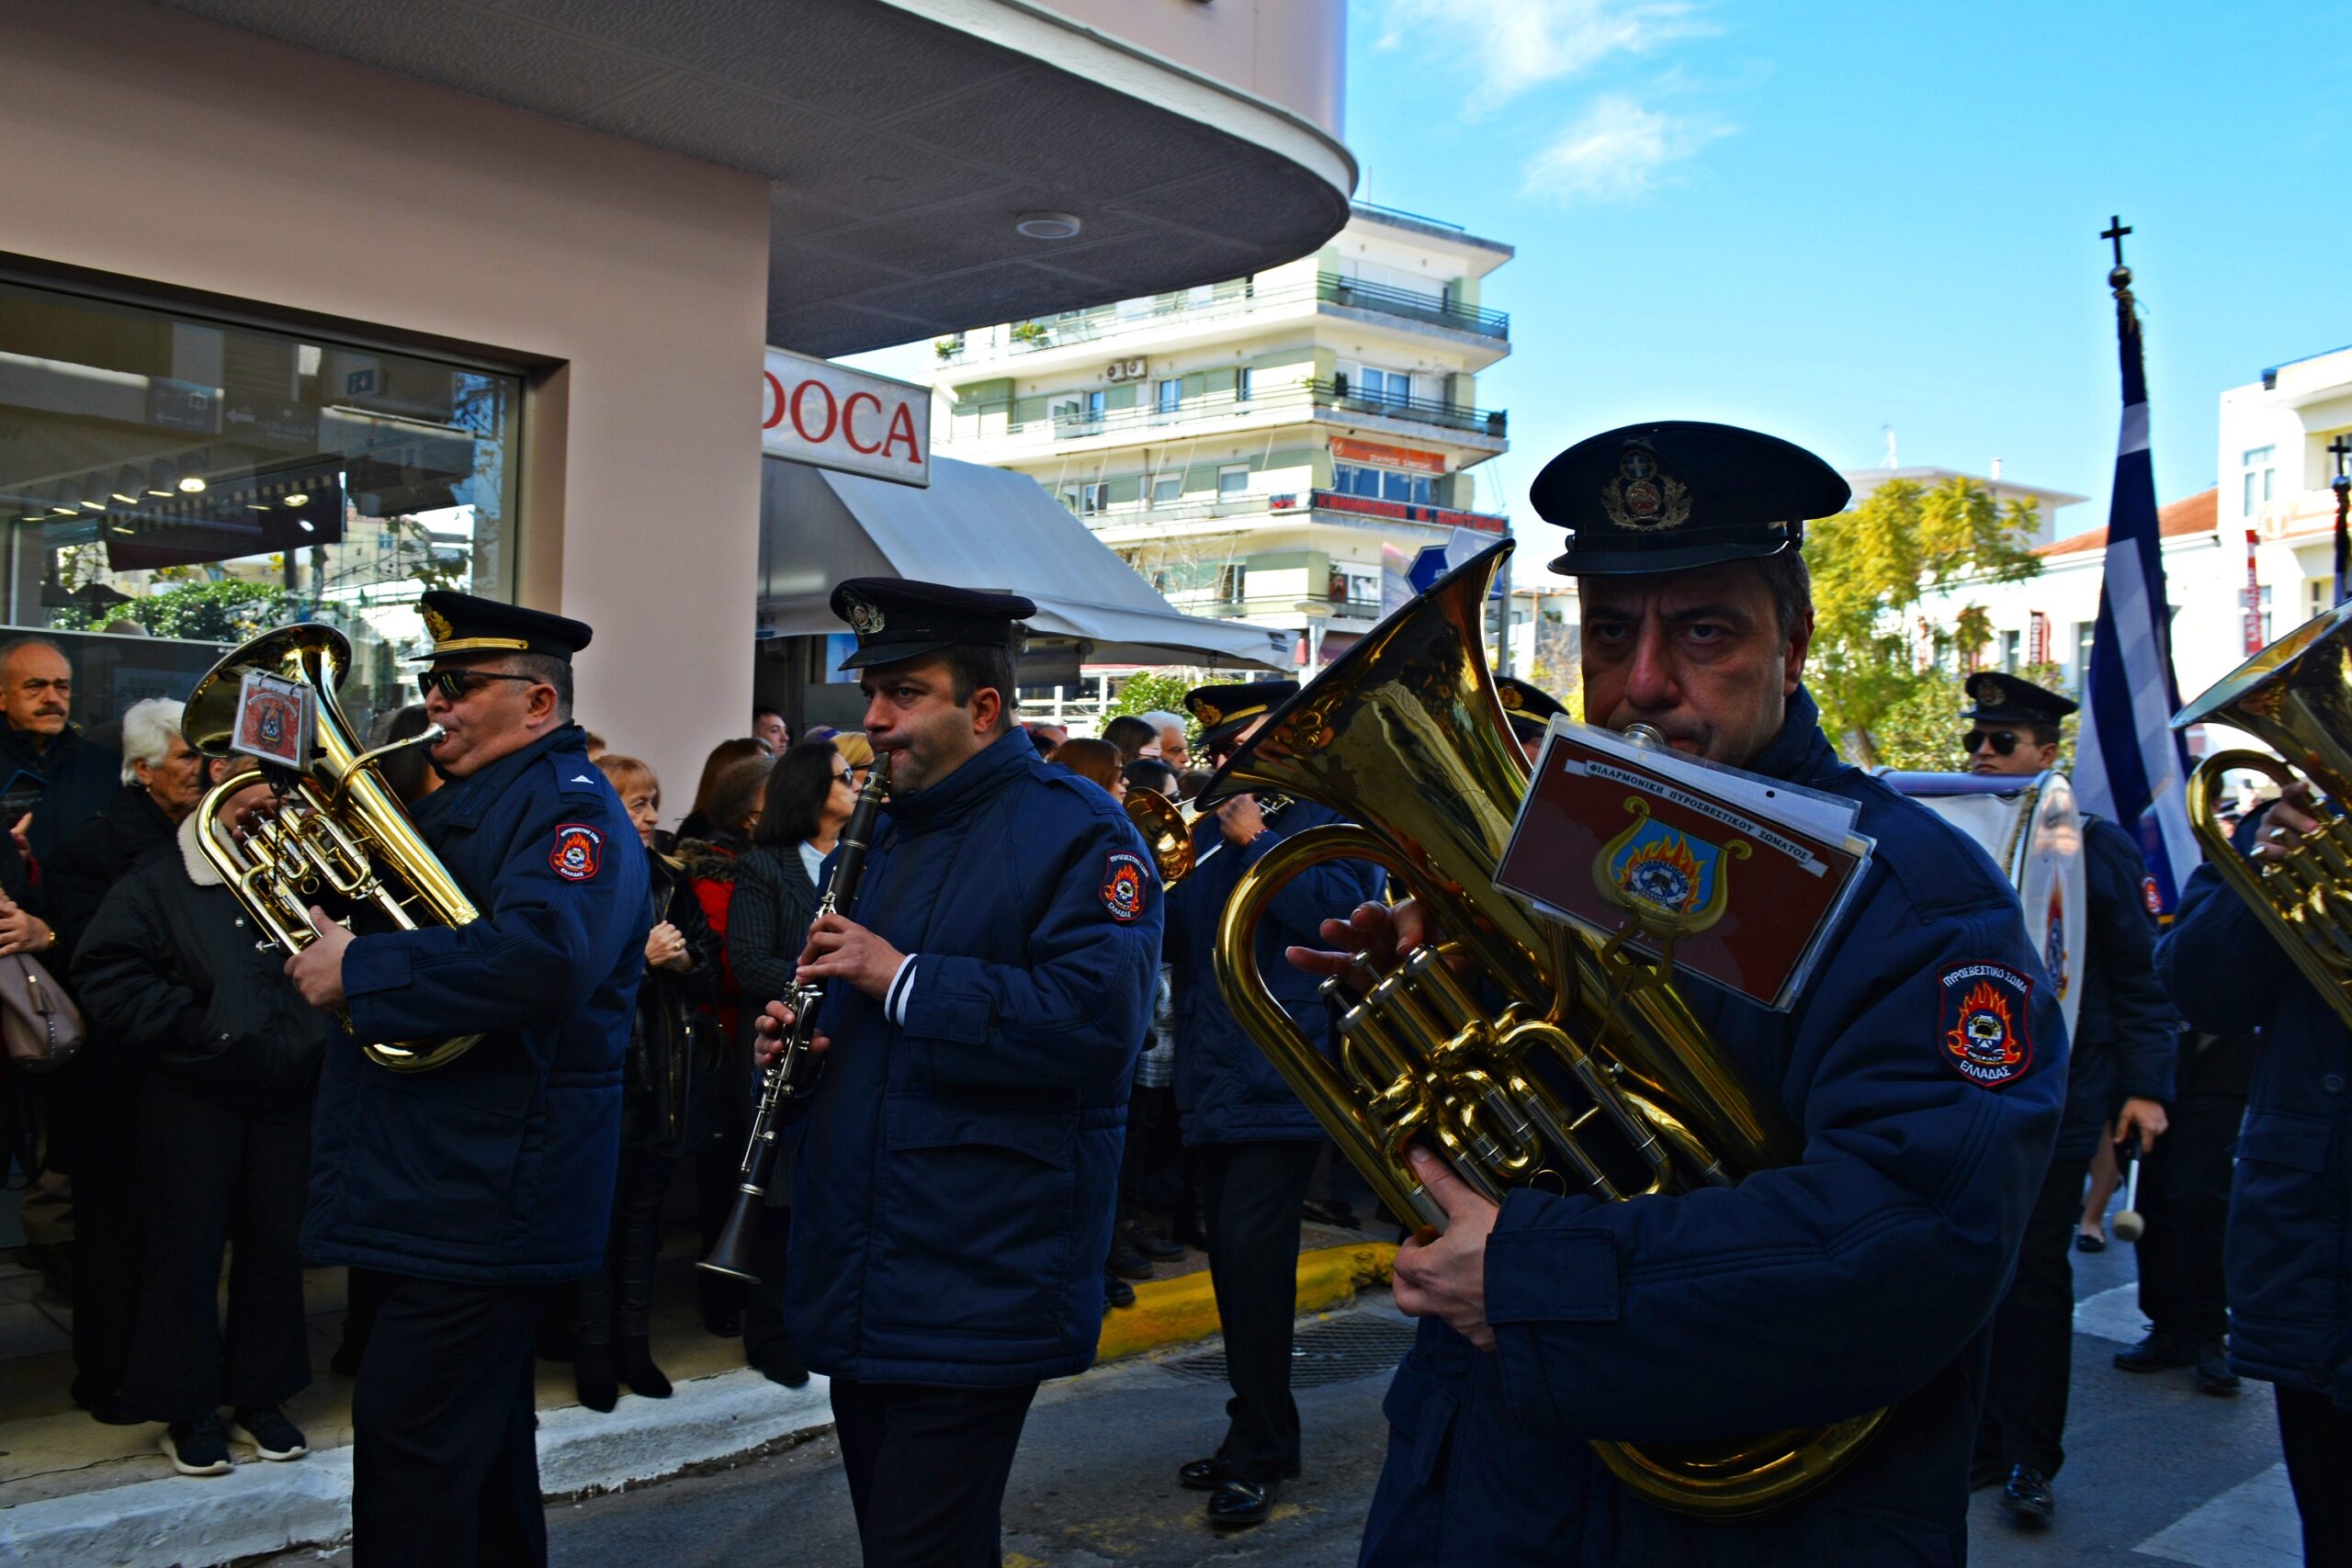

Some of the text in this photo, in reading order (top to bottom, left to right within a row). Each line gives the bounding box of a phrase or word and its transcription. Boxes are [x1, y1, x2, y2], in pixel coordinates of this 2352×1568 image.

[1589, 764, 1808, 860] ΦΙΛΑΡΜΟΝΙΚΗ ΠΥΡΟΣΒΕΣΤΙΚΟΥ ΣΩΜΑΤΟΣ
[1943, 965, 2028, 994] ΠΥΡΟΣΒΕΣΤΙΚΟ ΣΩΜΑ
[1960, 1060, 2011, 1079] ΕΛΛΑΔΑΣ
